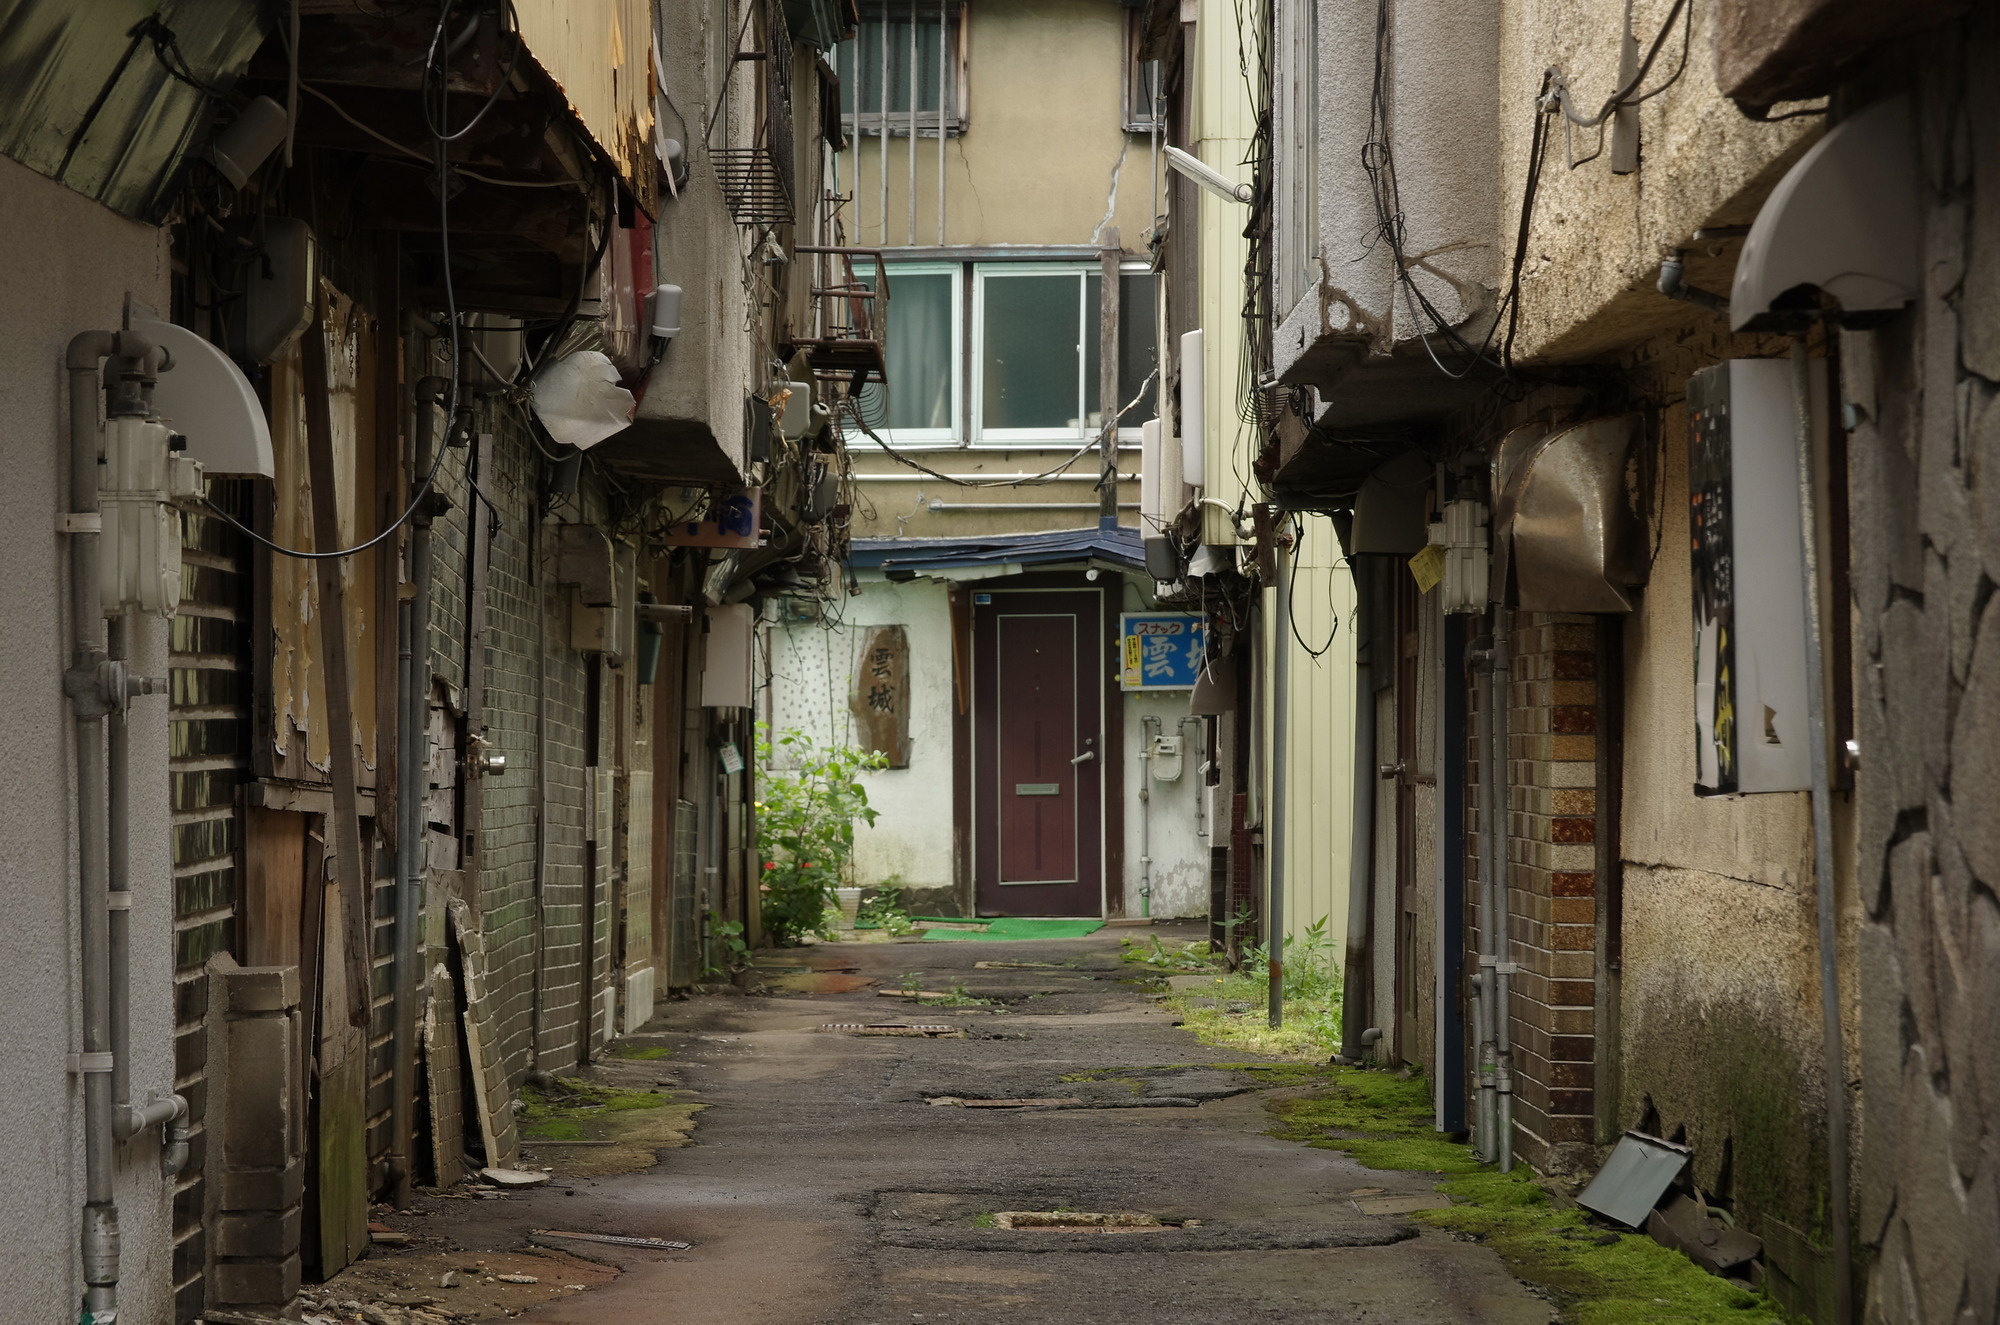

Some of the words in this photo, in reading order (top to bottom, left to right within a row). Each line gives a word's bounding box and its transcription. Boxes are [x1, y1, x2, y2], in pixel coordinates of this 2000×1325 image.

[1138, 623, 1181, 635] スナック
[868, 648, 896, 714] 雲城
